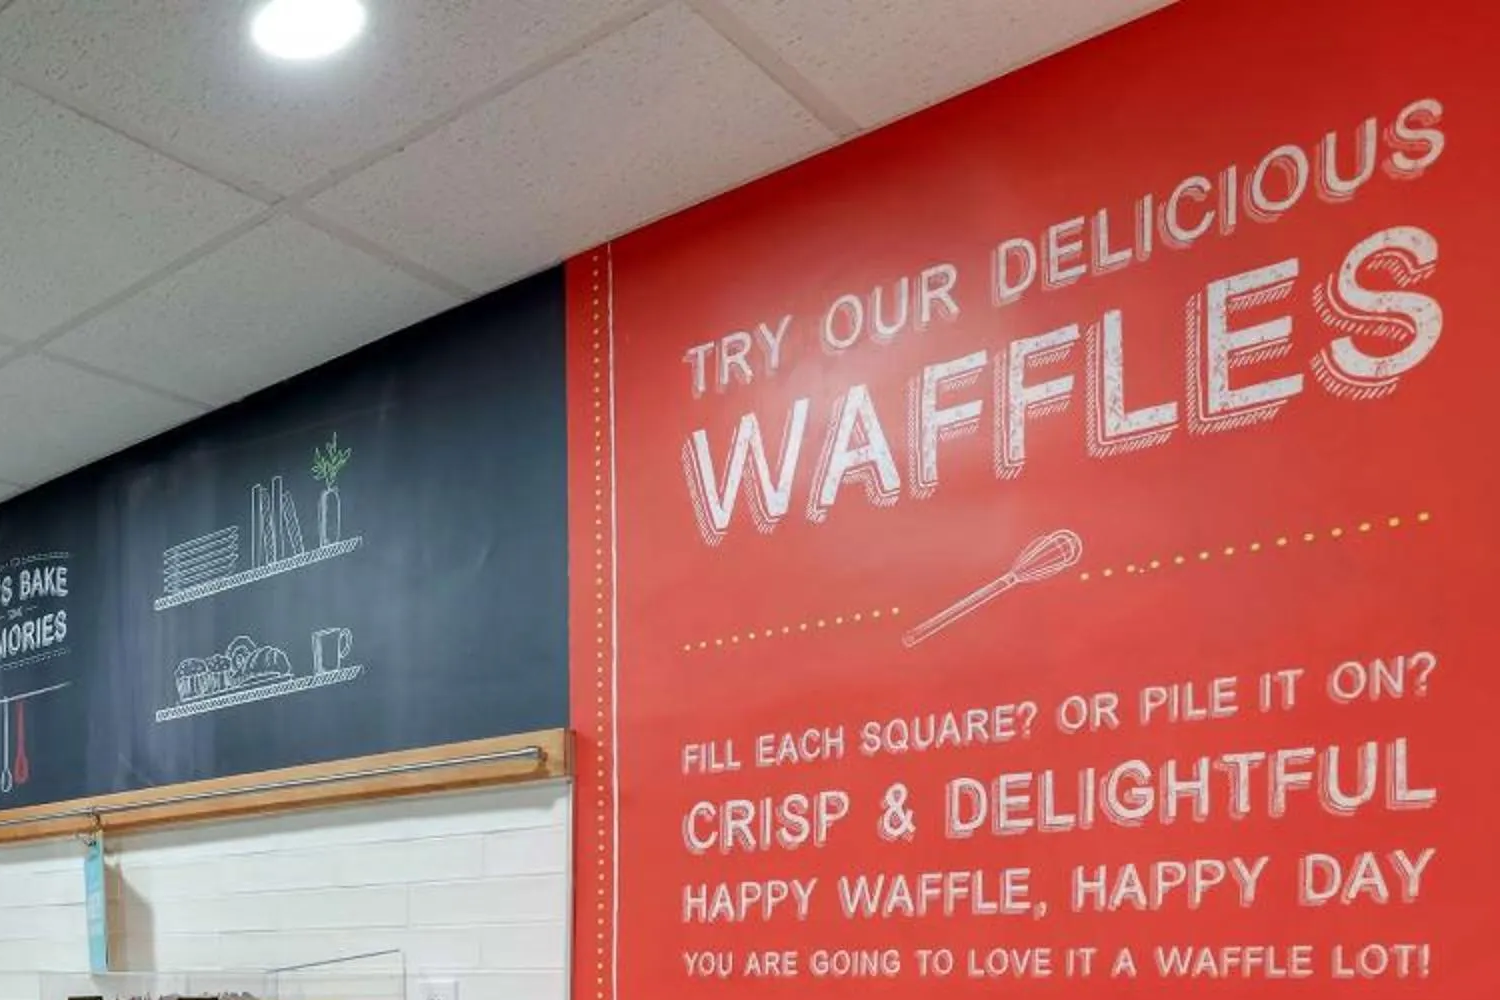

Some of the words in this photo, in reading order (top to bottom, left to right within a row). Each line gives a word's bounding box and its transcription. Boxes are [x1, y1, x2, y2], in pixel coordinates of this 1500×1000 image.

[682, 314, 793, 398] TRY
[821, 263, 961, 354] OUR
[991, 98, 1446, 306] DELICIOUS
[681, 224, 1445, 547] WAFFLES
[19, 565, 68, 600] BAKE
[682, 739, 742, 775] FILL
[755, 725, 845, 767] EACH
[861, 700, 1038, 757] SQUARE?
[1056, 691, 1120, 735] OR
[1140, 675, 1239, 726] PILE
[1259, 668, 1304, 712] IT
[1328, 651, 1437, 702] ON?
[682, 789, 850, 854] CRISP
[877, 781, 917, 843] &
[945, 737, 1438, 839] DELIGHTFUL
[682, 877, 818, 923] HAPPY
[837, 866, 1048, 920] WAFFLE,
[1071, 855, 1270, 912] HAPPY
[1299, 847, 1436, 907] DAY
[682, 950, 734, 977] YOU
[744, 950, 798, 977] ARE
[809, 948, 901, 977] GOING
[916, 948, 954, 977] TO
[967, 947, 1052, 978] LOVE
[1066, 947, 1097, 977] IT
[1111, 946, 1137, 978] A
[1155, 945, 1313, 978] WAFFLE
[1331, 943, 1431, 978] LOT!
